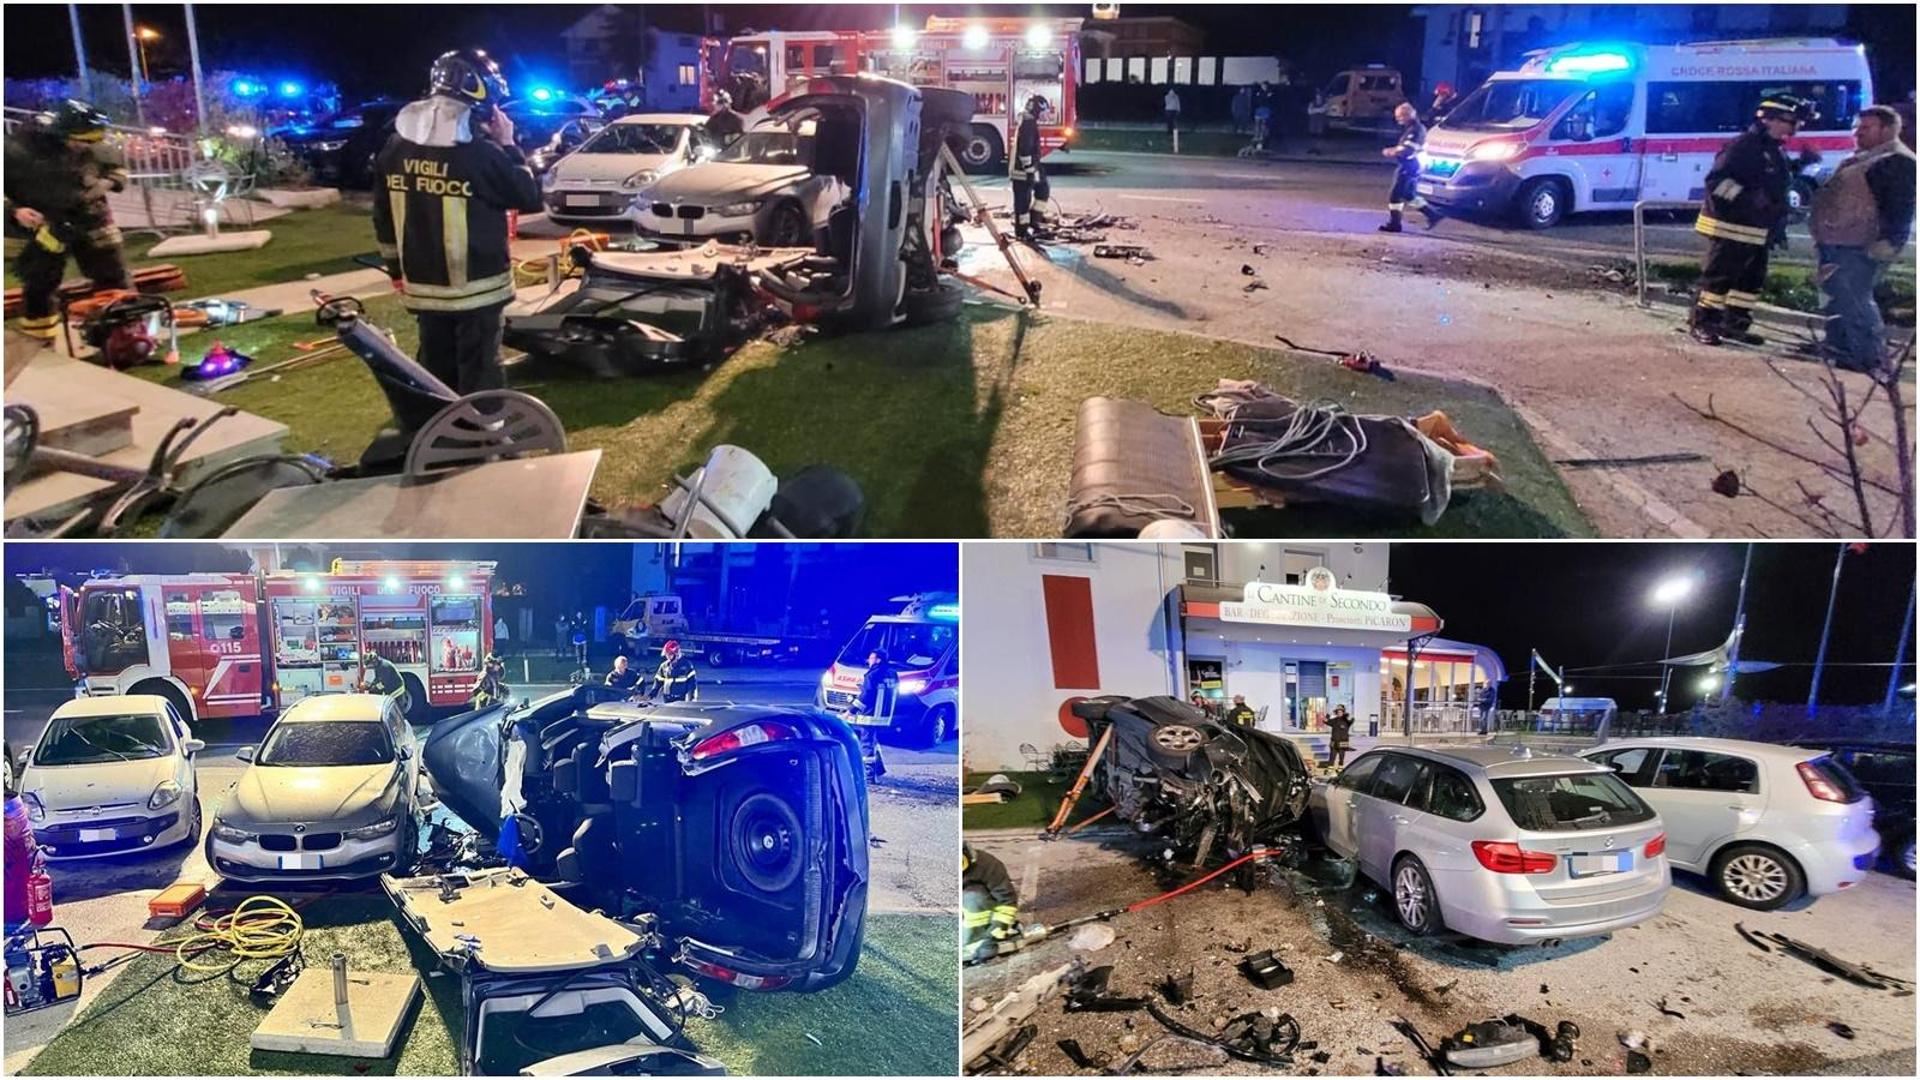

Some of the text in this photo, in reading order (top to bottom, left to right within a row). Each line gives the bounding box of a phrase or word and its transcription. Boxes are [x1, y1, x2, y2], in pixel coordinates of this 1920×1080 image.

[1671, 66, 1713, 76] CROCE
[403, 159, 448, 177] VIGILI
[416, 177, 473, 197] FUOCO
[331, 586, 361, 596] VIGILI
[408, 585, 441, 595] FUOCO
[1224, 606, 1243, 617] BAR
[1250, 609, 1318, 623] DEGZIONE
[220, 641, 242, 653] 115
